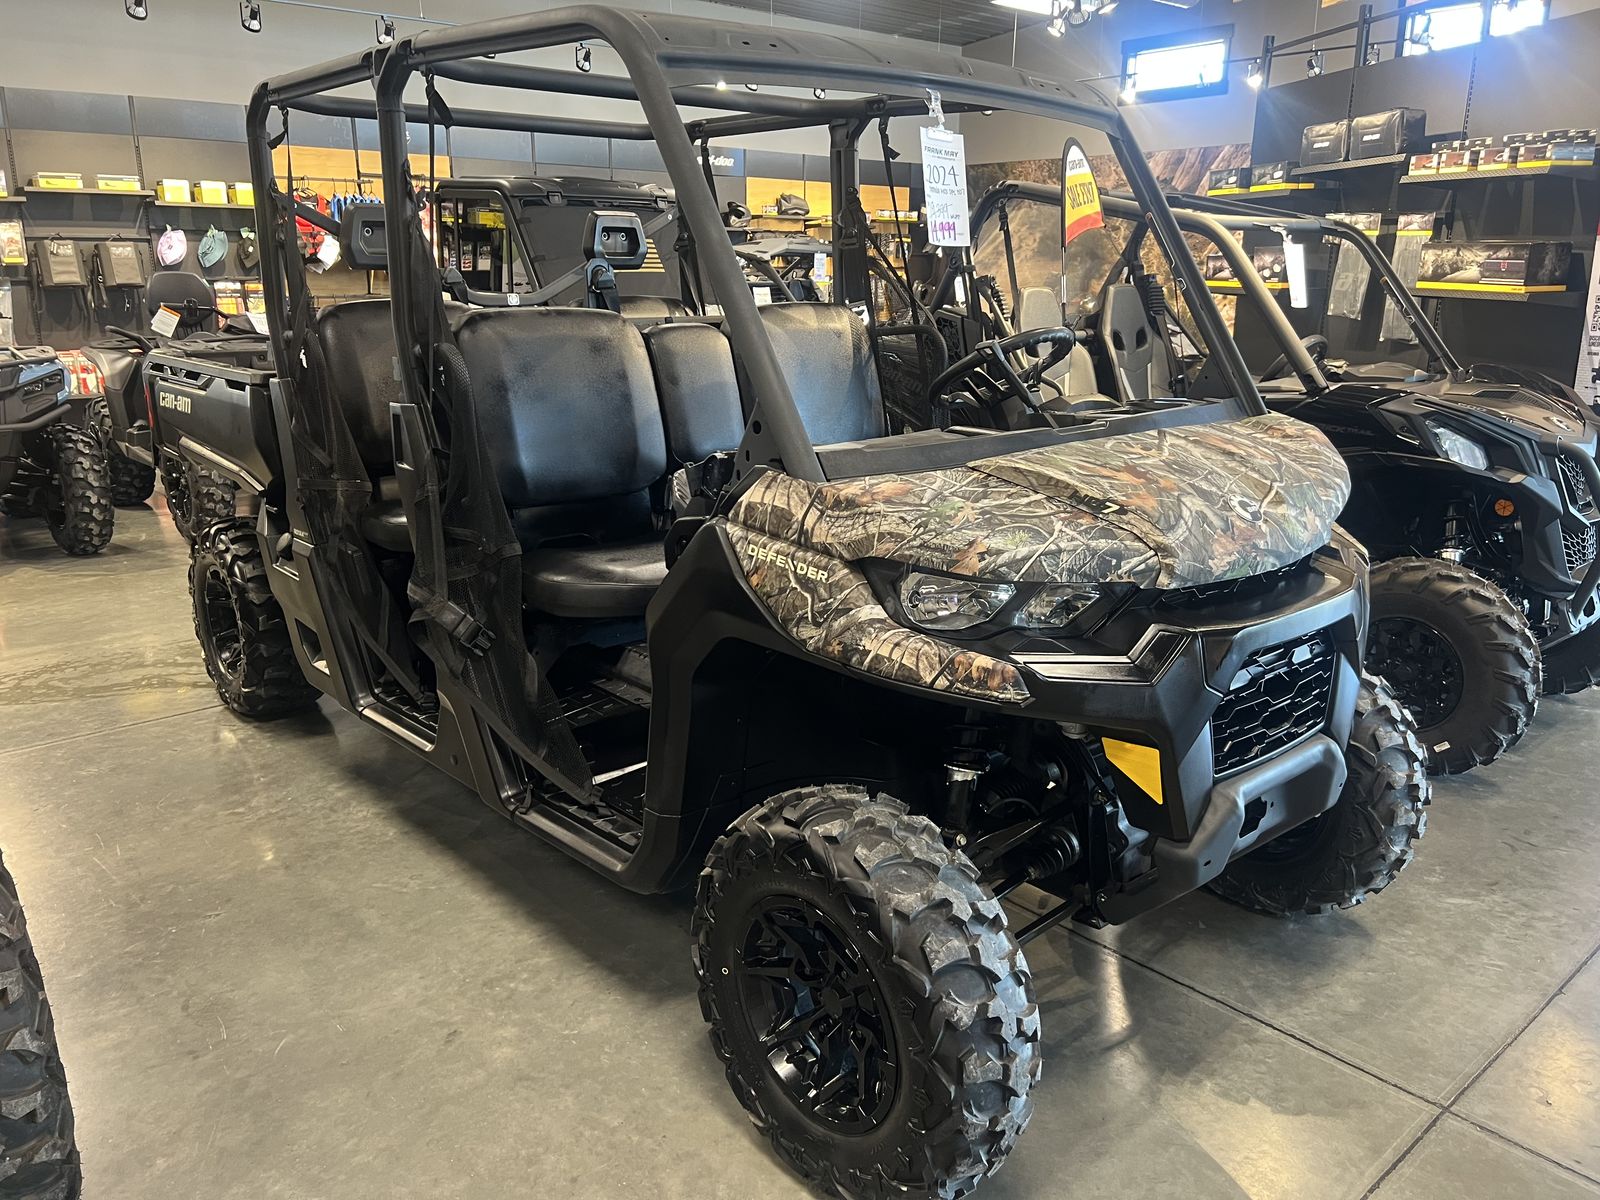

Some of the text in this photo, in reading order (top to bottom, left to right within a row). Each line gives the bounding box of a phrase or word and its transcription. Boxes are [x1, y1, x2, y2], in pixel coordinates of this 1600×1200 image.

[924, 145, 959, 157] FRANK MAY
[927, 164, 960, 186] 2024
[160, 391, 192, 414] can-am
[747, 544, 828, 583] DEFENDER
